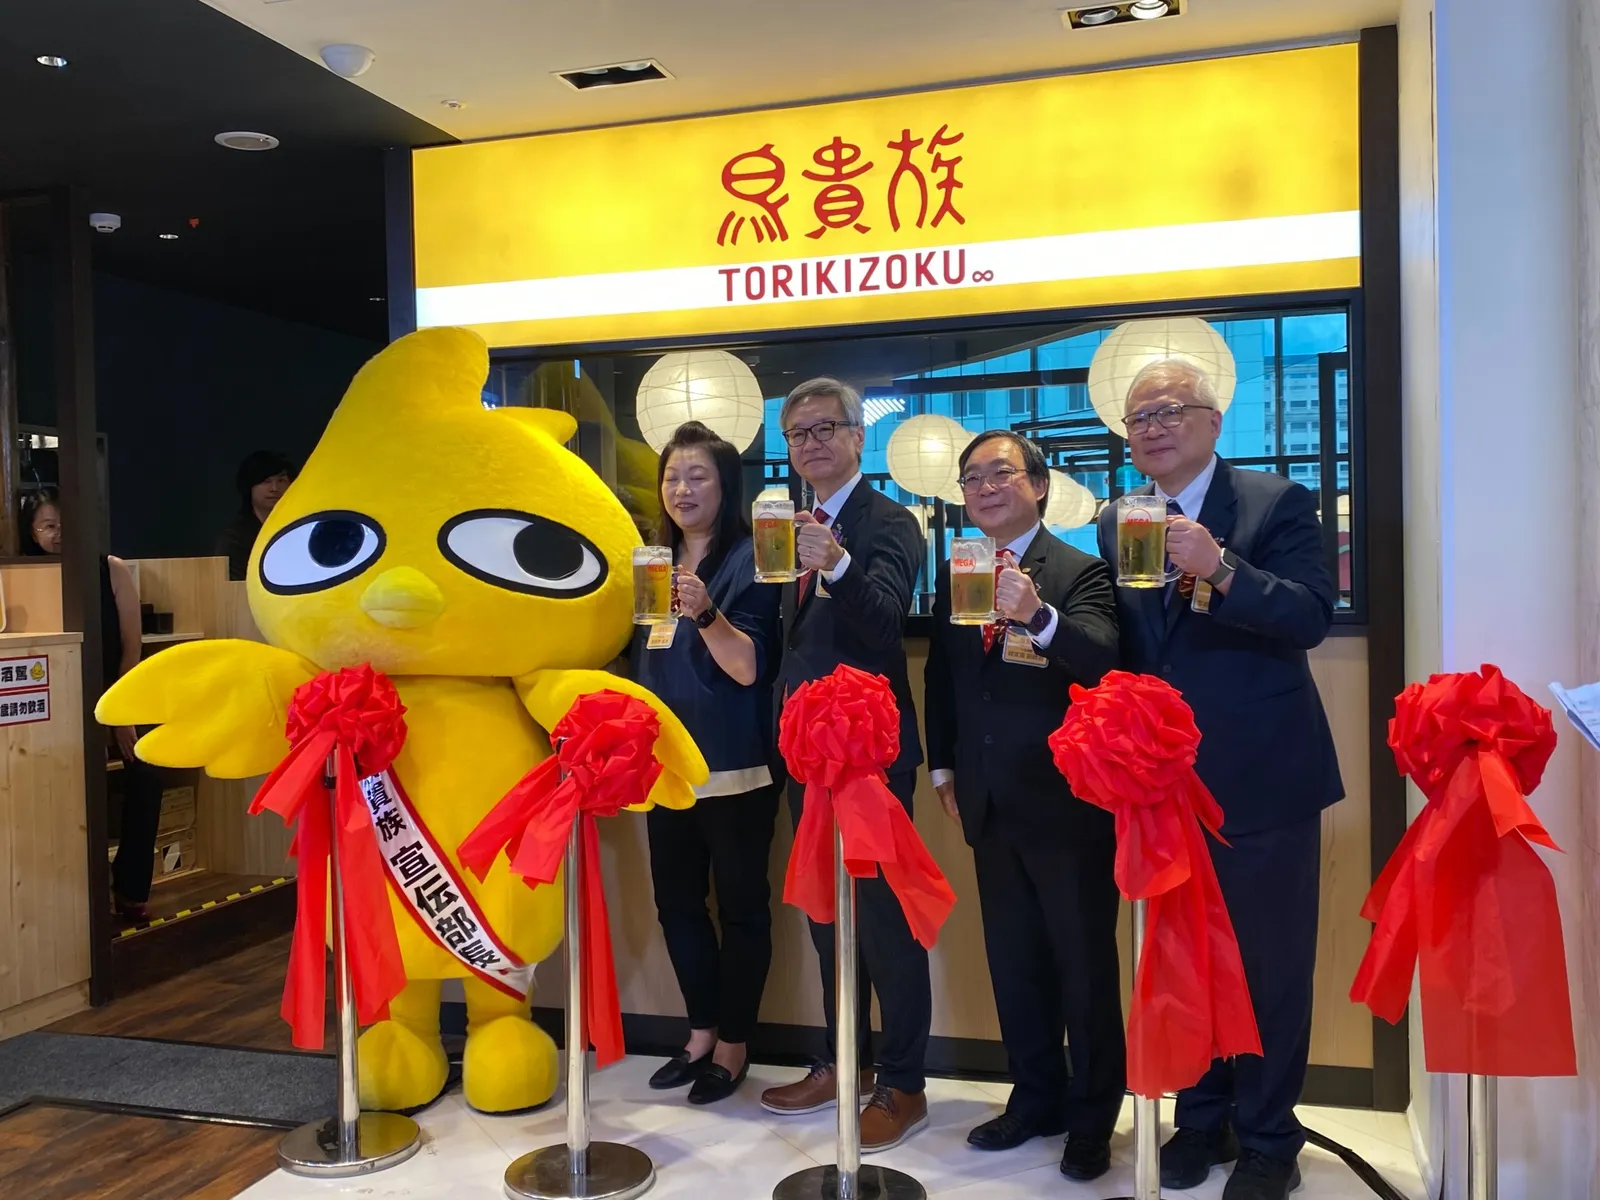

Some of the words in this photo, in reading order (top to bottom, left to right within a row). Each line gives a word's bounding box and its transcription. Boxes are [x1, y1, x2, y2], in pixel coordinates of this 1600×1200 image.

[717, 124, 966, 246] 鳥貴族
[718, 249, 966, 301] TORIKIZOKU
[1126, 517, 1151, 526] MEGA
[647, 564, 668, 573] MEGA
[953, 558, 975, 567] MEGA
[1, 665, 28, 682] 酒駕
[363, 772, 407, 843] 貴族
